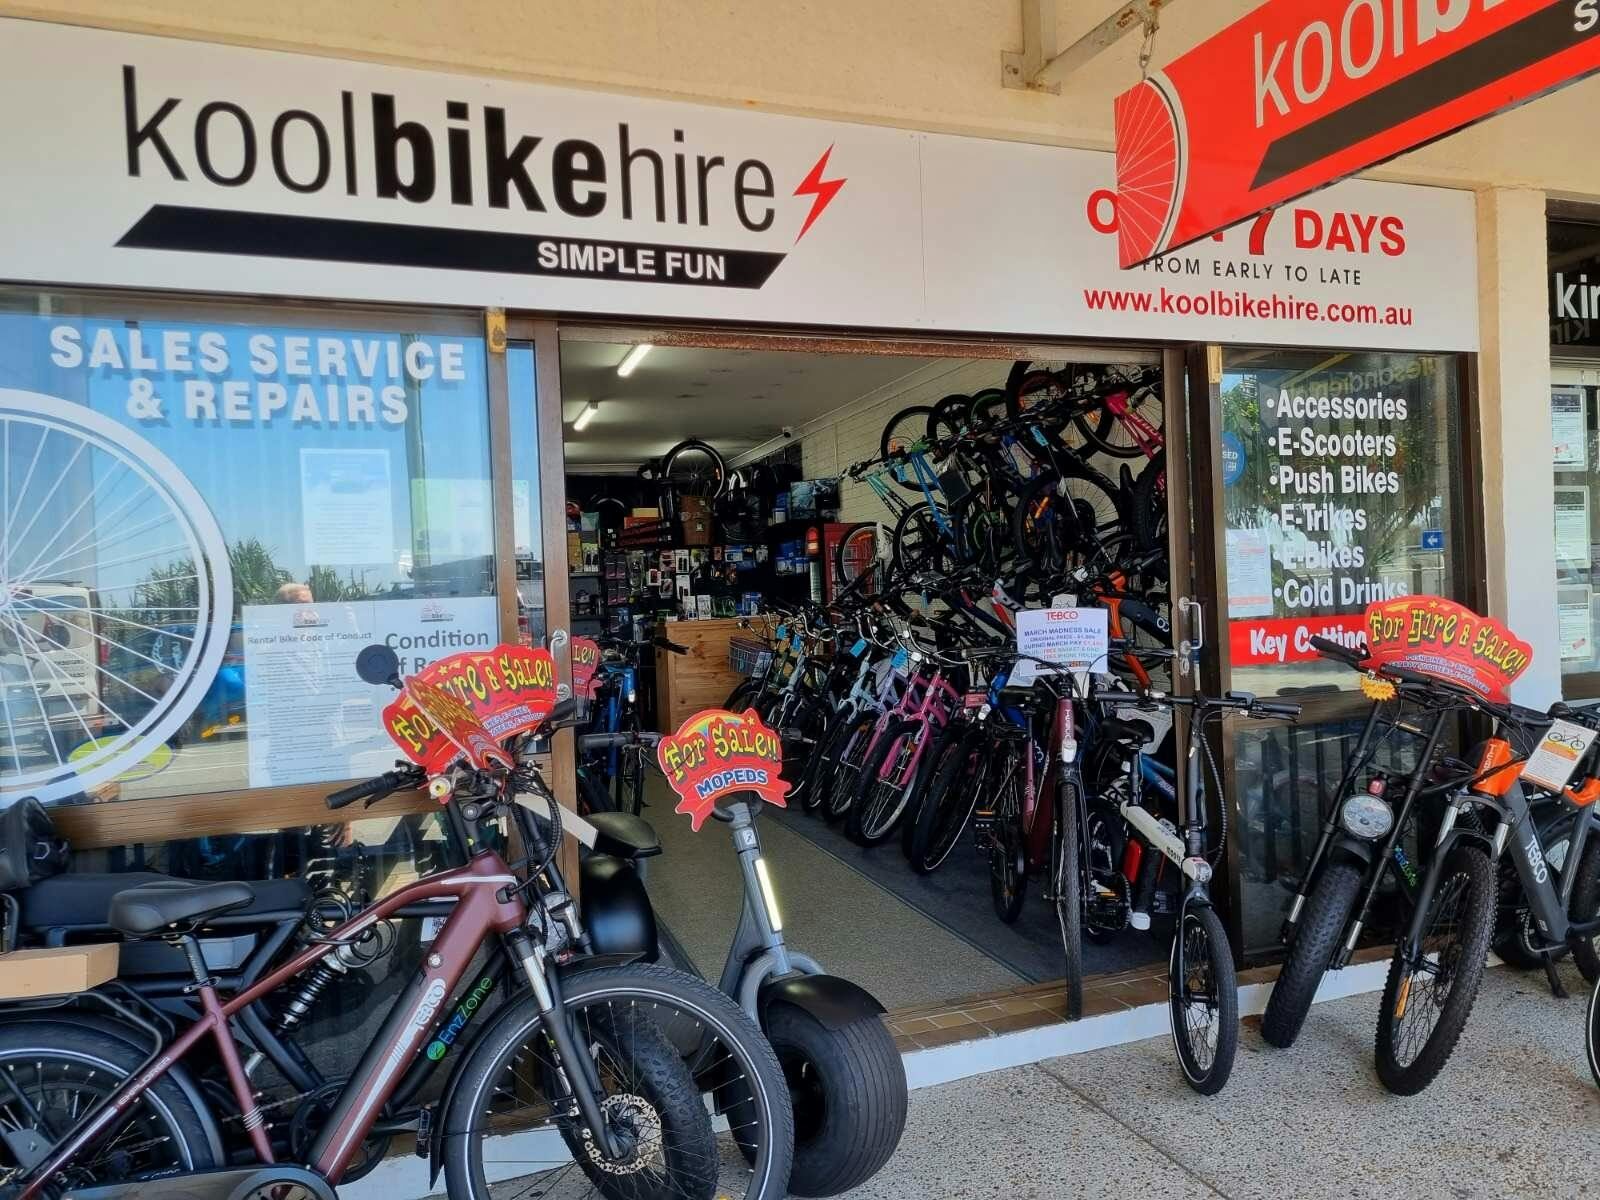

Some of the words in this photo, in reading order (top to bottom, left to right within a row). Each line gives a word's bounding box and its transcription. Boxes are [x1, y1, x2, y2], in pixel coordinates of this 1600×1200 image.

[122, 64, 776, 233] koolbikehire
[1293, 208, 1406, 257] DAYS
[537, 241, 656, 276] SIMPLE
[665, 250, 728, 281] FUN
[1143, 256, 1201, 276] FROM
[1213, 259, 1273, 281] EARLY
[1284, 264, 1308, 283] TO
[1319, 267, 1362, 286] LATE
[1084, 286, 1413, 326] www.koolbikehire.com.au
[49, 326, 229, 375] SALES
[249, 334, 466, 380] SERVICE
[125, 378, 165, 421] &
[184, 382, 409, 425] REPAIRS
[1276, 388, 1408, 421] Accessories
[1278, 427, 1396, 457] E-Scooters
[1280, 465, 1334, 495] Push
[1341, 464, 1399, 494] Bikes
[1281, 500, 1367, 532] E-Trikes
[1283, 540, 1365, 571] E-Bikes
[1284, 577, 1334, 608] Cold
[1340, 574, 1408, 606] Drinks
[1045, 610, 1079, 621] TEBCO
[1369, 609, 1404, 642] For
[1407, 608, 1459, 644] Hire
[1458, 623, 1472, 646] &
[279, 633, 299, 644] Bike
[300, 633, 322, 642] Code
[324, 632, 335, 642] of
[385, 629, 489, 650] Condition
[1250, 627, 1288, 662] Key
[664, 740, 704, 782] For
[1478, 743, 1497, 784] TEB
[696, 768, 768, 799] MOPEDS
[1524, 836, 1548, 884] TEBCO
[437, 976, 493, 1046] EnzZone
